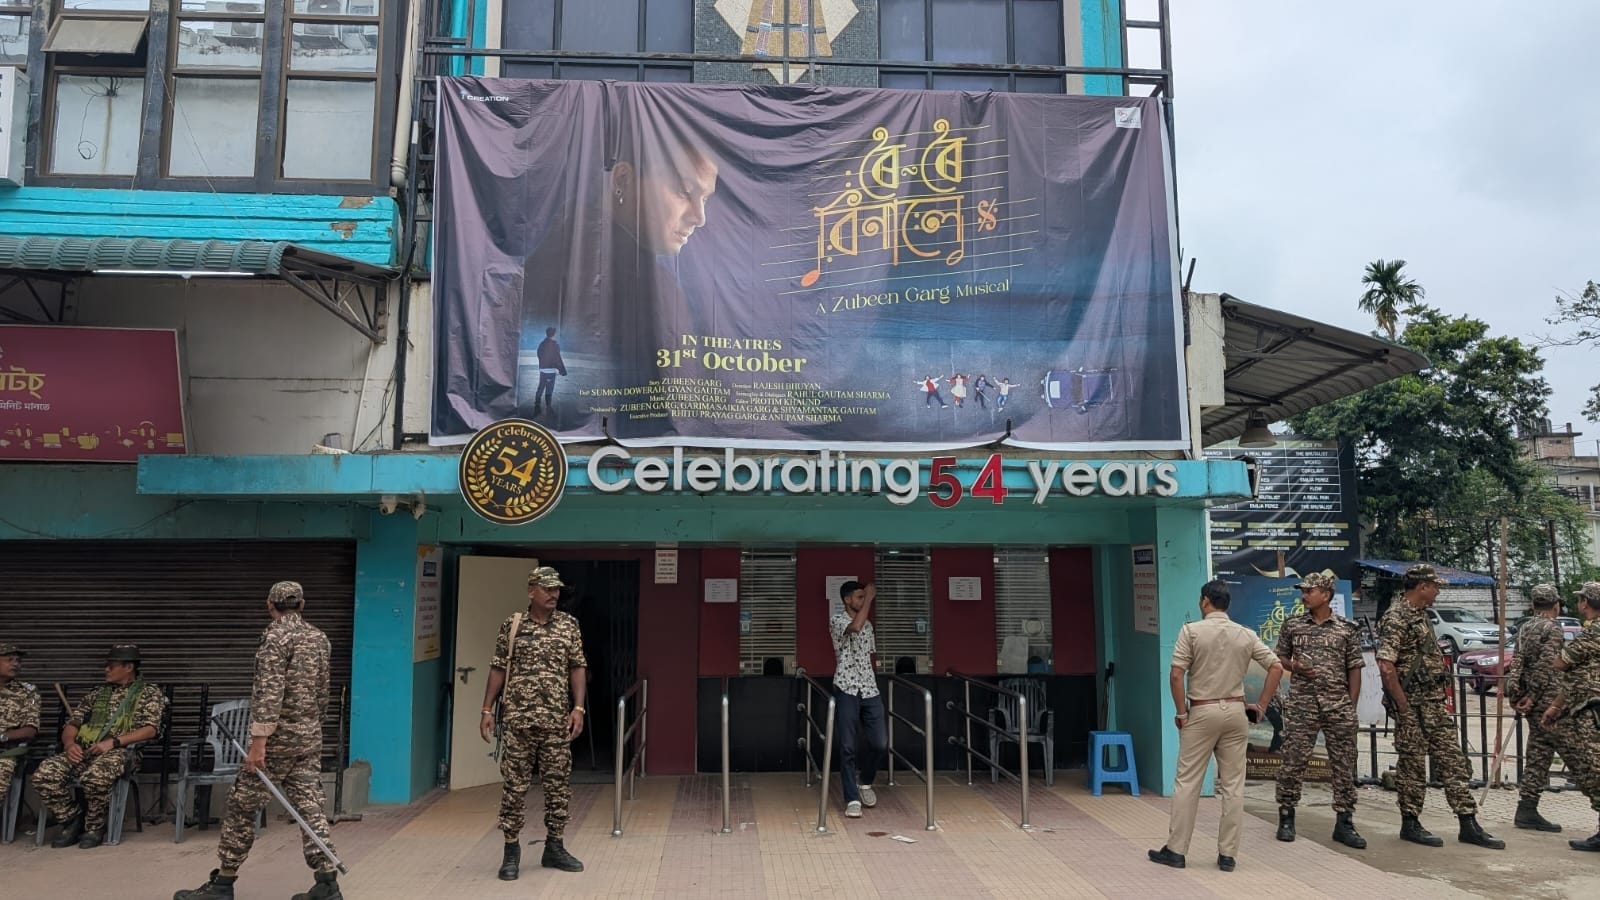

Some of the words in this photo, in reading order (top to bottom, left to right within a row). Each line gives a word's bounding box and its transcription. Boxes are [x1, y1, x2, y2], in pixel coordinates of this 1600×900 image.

[816, 303, 827, 315] A
[832, 292, 899, 312] Zubeen
[905, 286, 950, 304] Garg
[956, 279, 1009, 298] Musical
[682, 334, 697, 346] IN
[701, 336, 782, 350] THEATRES
[656, 348, 697, 368] 31st
[703, 352, 807, 373] October
[662, 378, 696, 386] ZUBEEN
[698, 379, 722, 388] GARG
[753, 382, 784, 390] RAJESH
[591, 388, 623, 397] SUMON
[668, 386, 692, 394] GYAN
[694, 387, 731, 396] GAUTAM
[787, 391, 817, 399] RAHUL
[818, 391, 854, 399] GAUTAM
[856, 391, 891, 400] SHARMA
[666, 394, 700, 402] ZUBEEN
[702, 395, 727, 403] GARG
[750, 397, 782, 405] PROTIM
[620, 403, 651, 412] ZUBEEN
[681, 402, 716, 411] GARIMA
[718, 404, 745, 412] SAIKIA
[746, 405, 771, 413] GARG
[781, 406, 839, 414] SHYAMANTAK
[841, 407, 877, 415] GAUTAM
[700, 411, 734, 419] PRAYAG
[735, 413, 759, 421] GARG
[769, 414, 805, 422] ANUPAM
[806, 414, 842, 422] SHARMA
[497, 426, 554, 458] Celebrating
[490, 446, 538, 487] 54
[587, 445, 920, 505] Celebrating
[1026, 460, 1179, 505] years
[491, 475, 523, 495] YEARS
